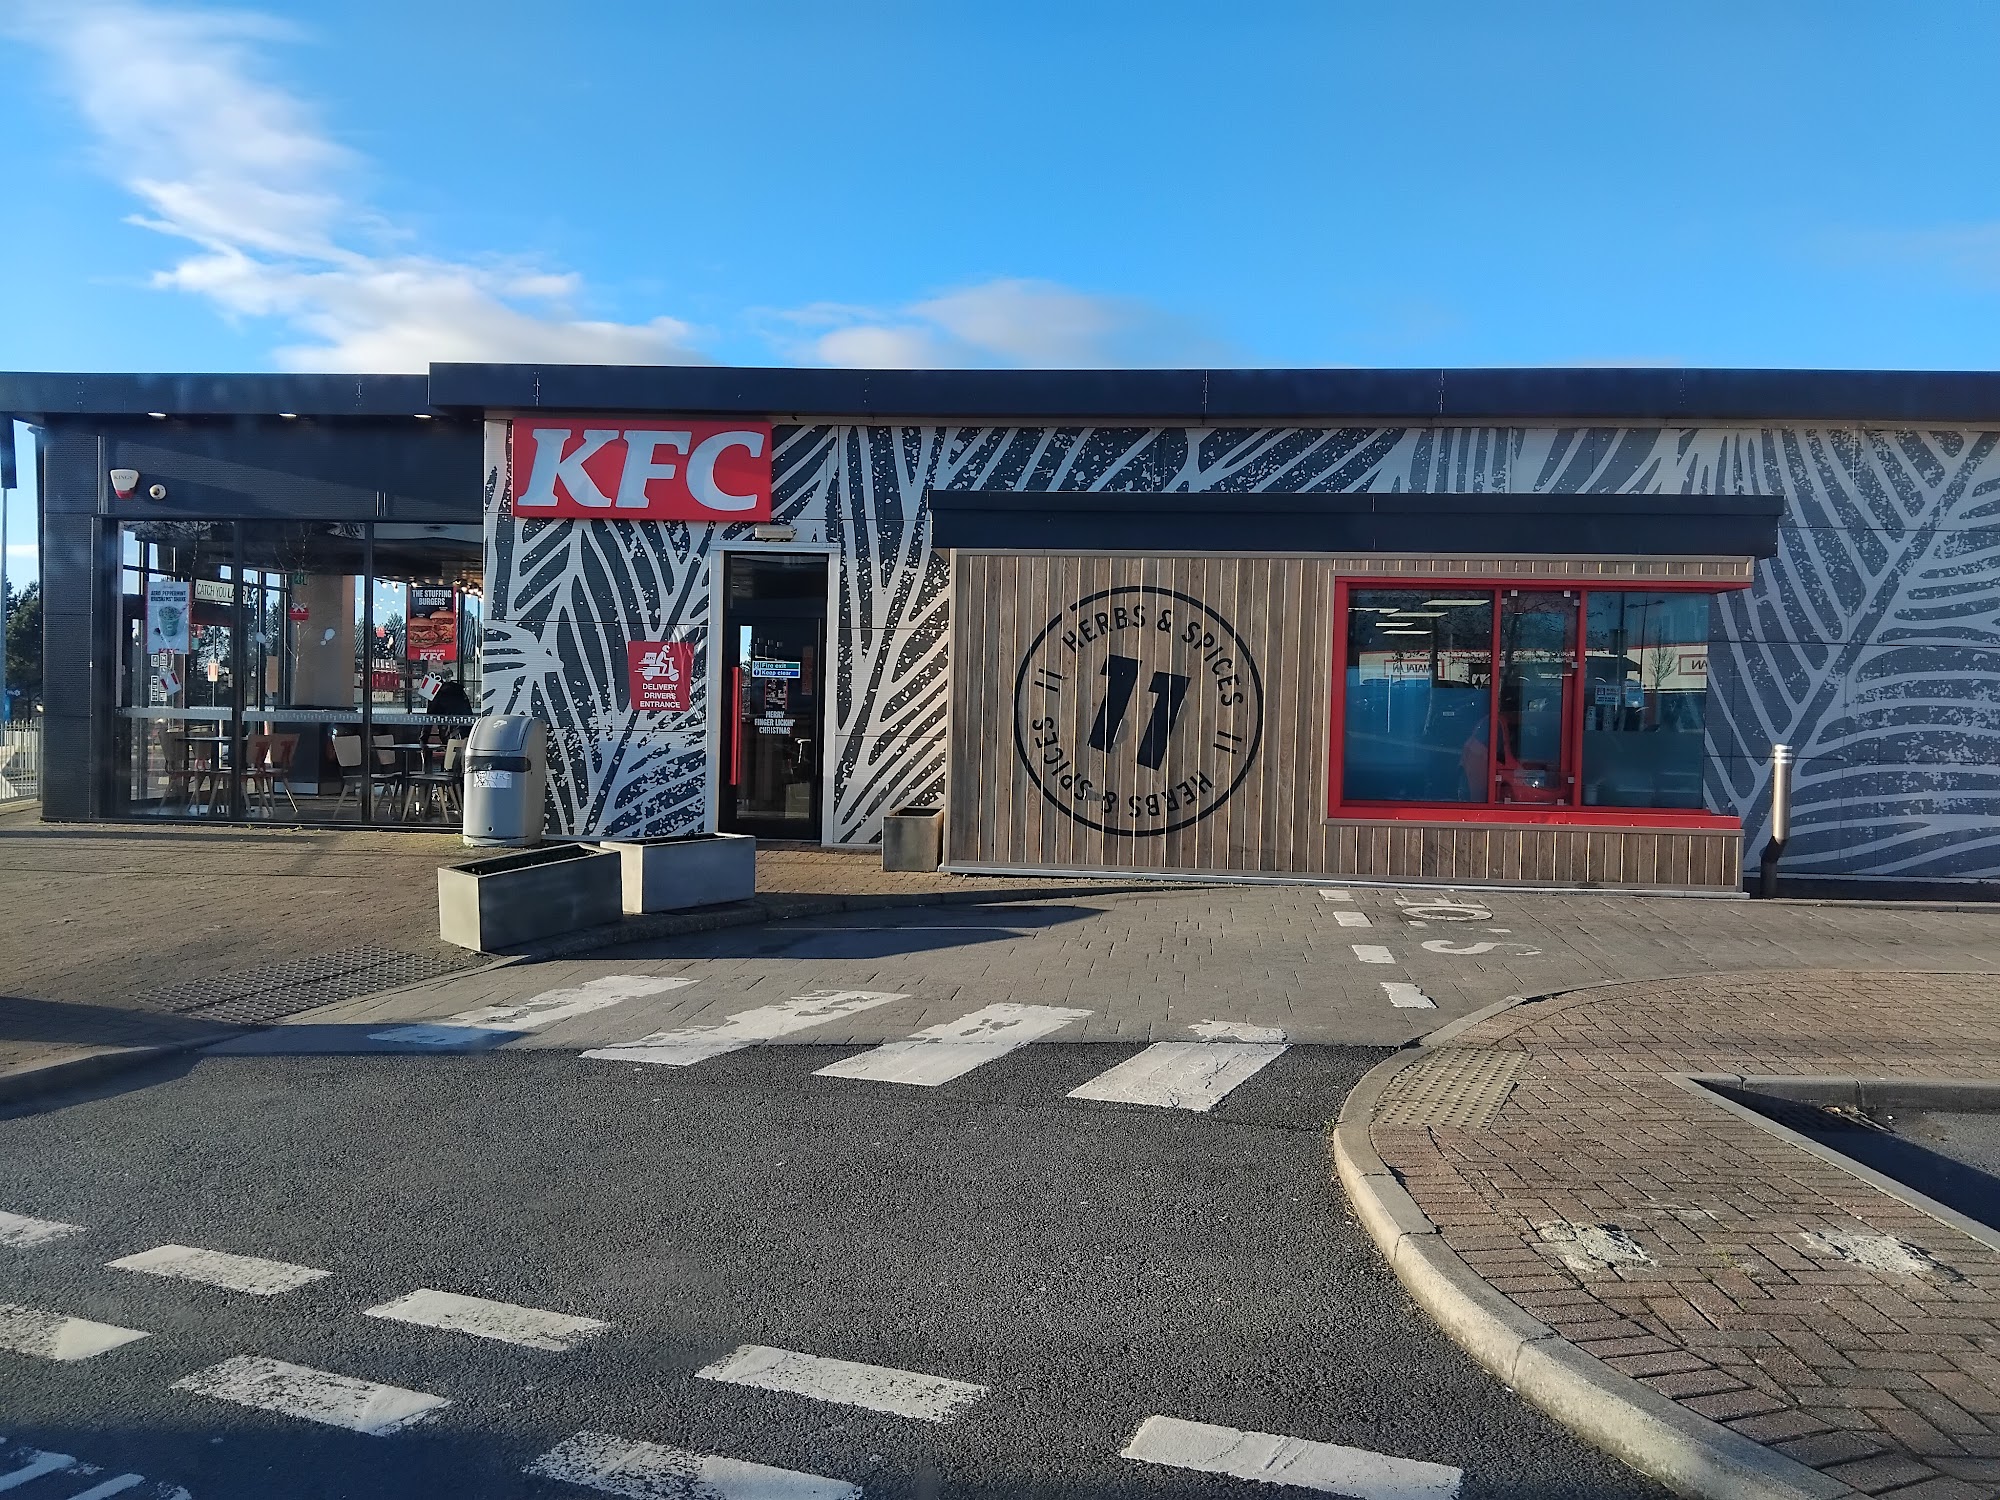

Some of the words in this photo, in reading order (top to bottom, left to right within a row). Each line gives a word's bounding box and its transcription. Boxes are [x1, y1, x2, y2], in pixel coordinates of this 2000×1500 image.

[517, 428, 765, 511] KFC
[196, 584, 214, 598] CATCH
[216, 584, 226, 599] YOU
[412, 590, 424, 598] THE
[424, 590, 452, 598] STUFFING
[418, 598, 446, 606] BURGERS
[420, 652, 446, 660] KFC
[1062, 605, 1146, 654] HERBS
[1157, 609, 1175, 634] &
[1181, 622, 1244, 708] SPICES
[644, 692, 676, 700] DRIVERS
[640, 700, 680, 708] ENTRANCE
[766, 710, 784, 718] MERRY
[1087, 653, 1191, 771] 11
[754, 718, 774, 726] FINGER
[759, 726, 790, 734] CHRISTMAS
[1032, 716, 1093, 801] SPICES
[488, 771, 511, 780] KFC
[1128, 769, 1214, 818] HERBS
[1101, 791, 1117, 813] &
